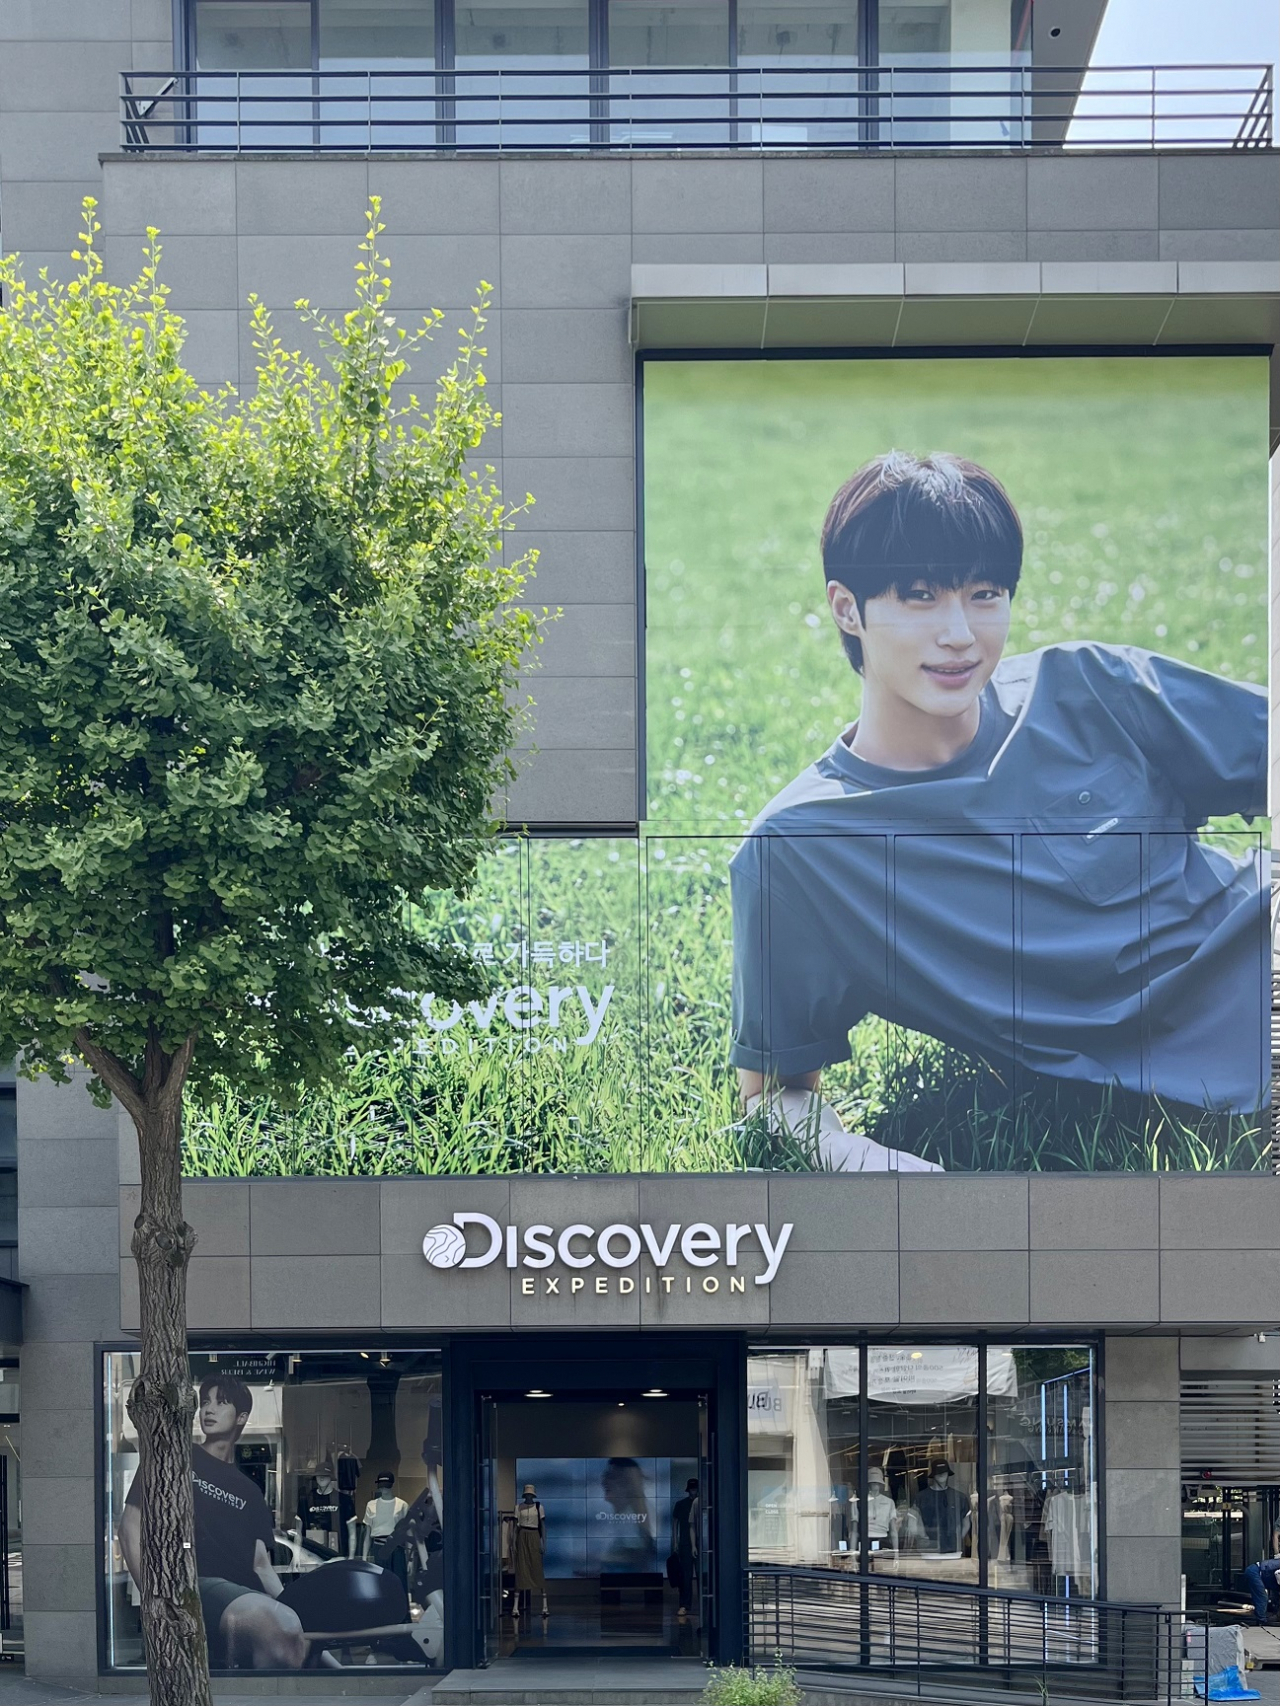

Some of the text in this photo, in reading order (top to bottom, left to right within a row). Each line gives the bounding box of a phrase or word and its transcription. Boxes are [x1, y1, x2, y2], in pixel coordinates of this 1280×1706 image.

[502, 940, 611, 968] 가득하다
[452, 1212, 794, 1285] Discovery
[521, 1276, 746, 1295] EXPEDITION
[596, 1511, 648, 1523] Discovery
